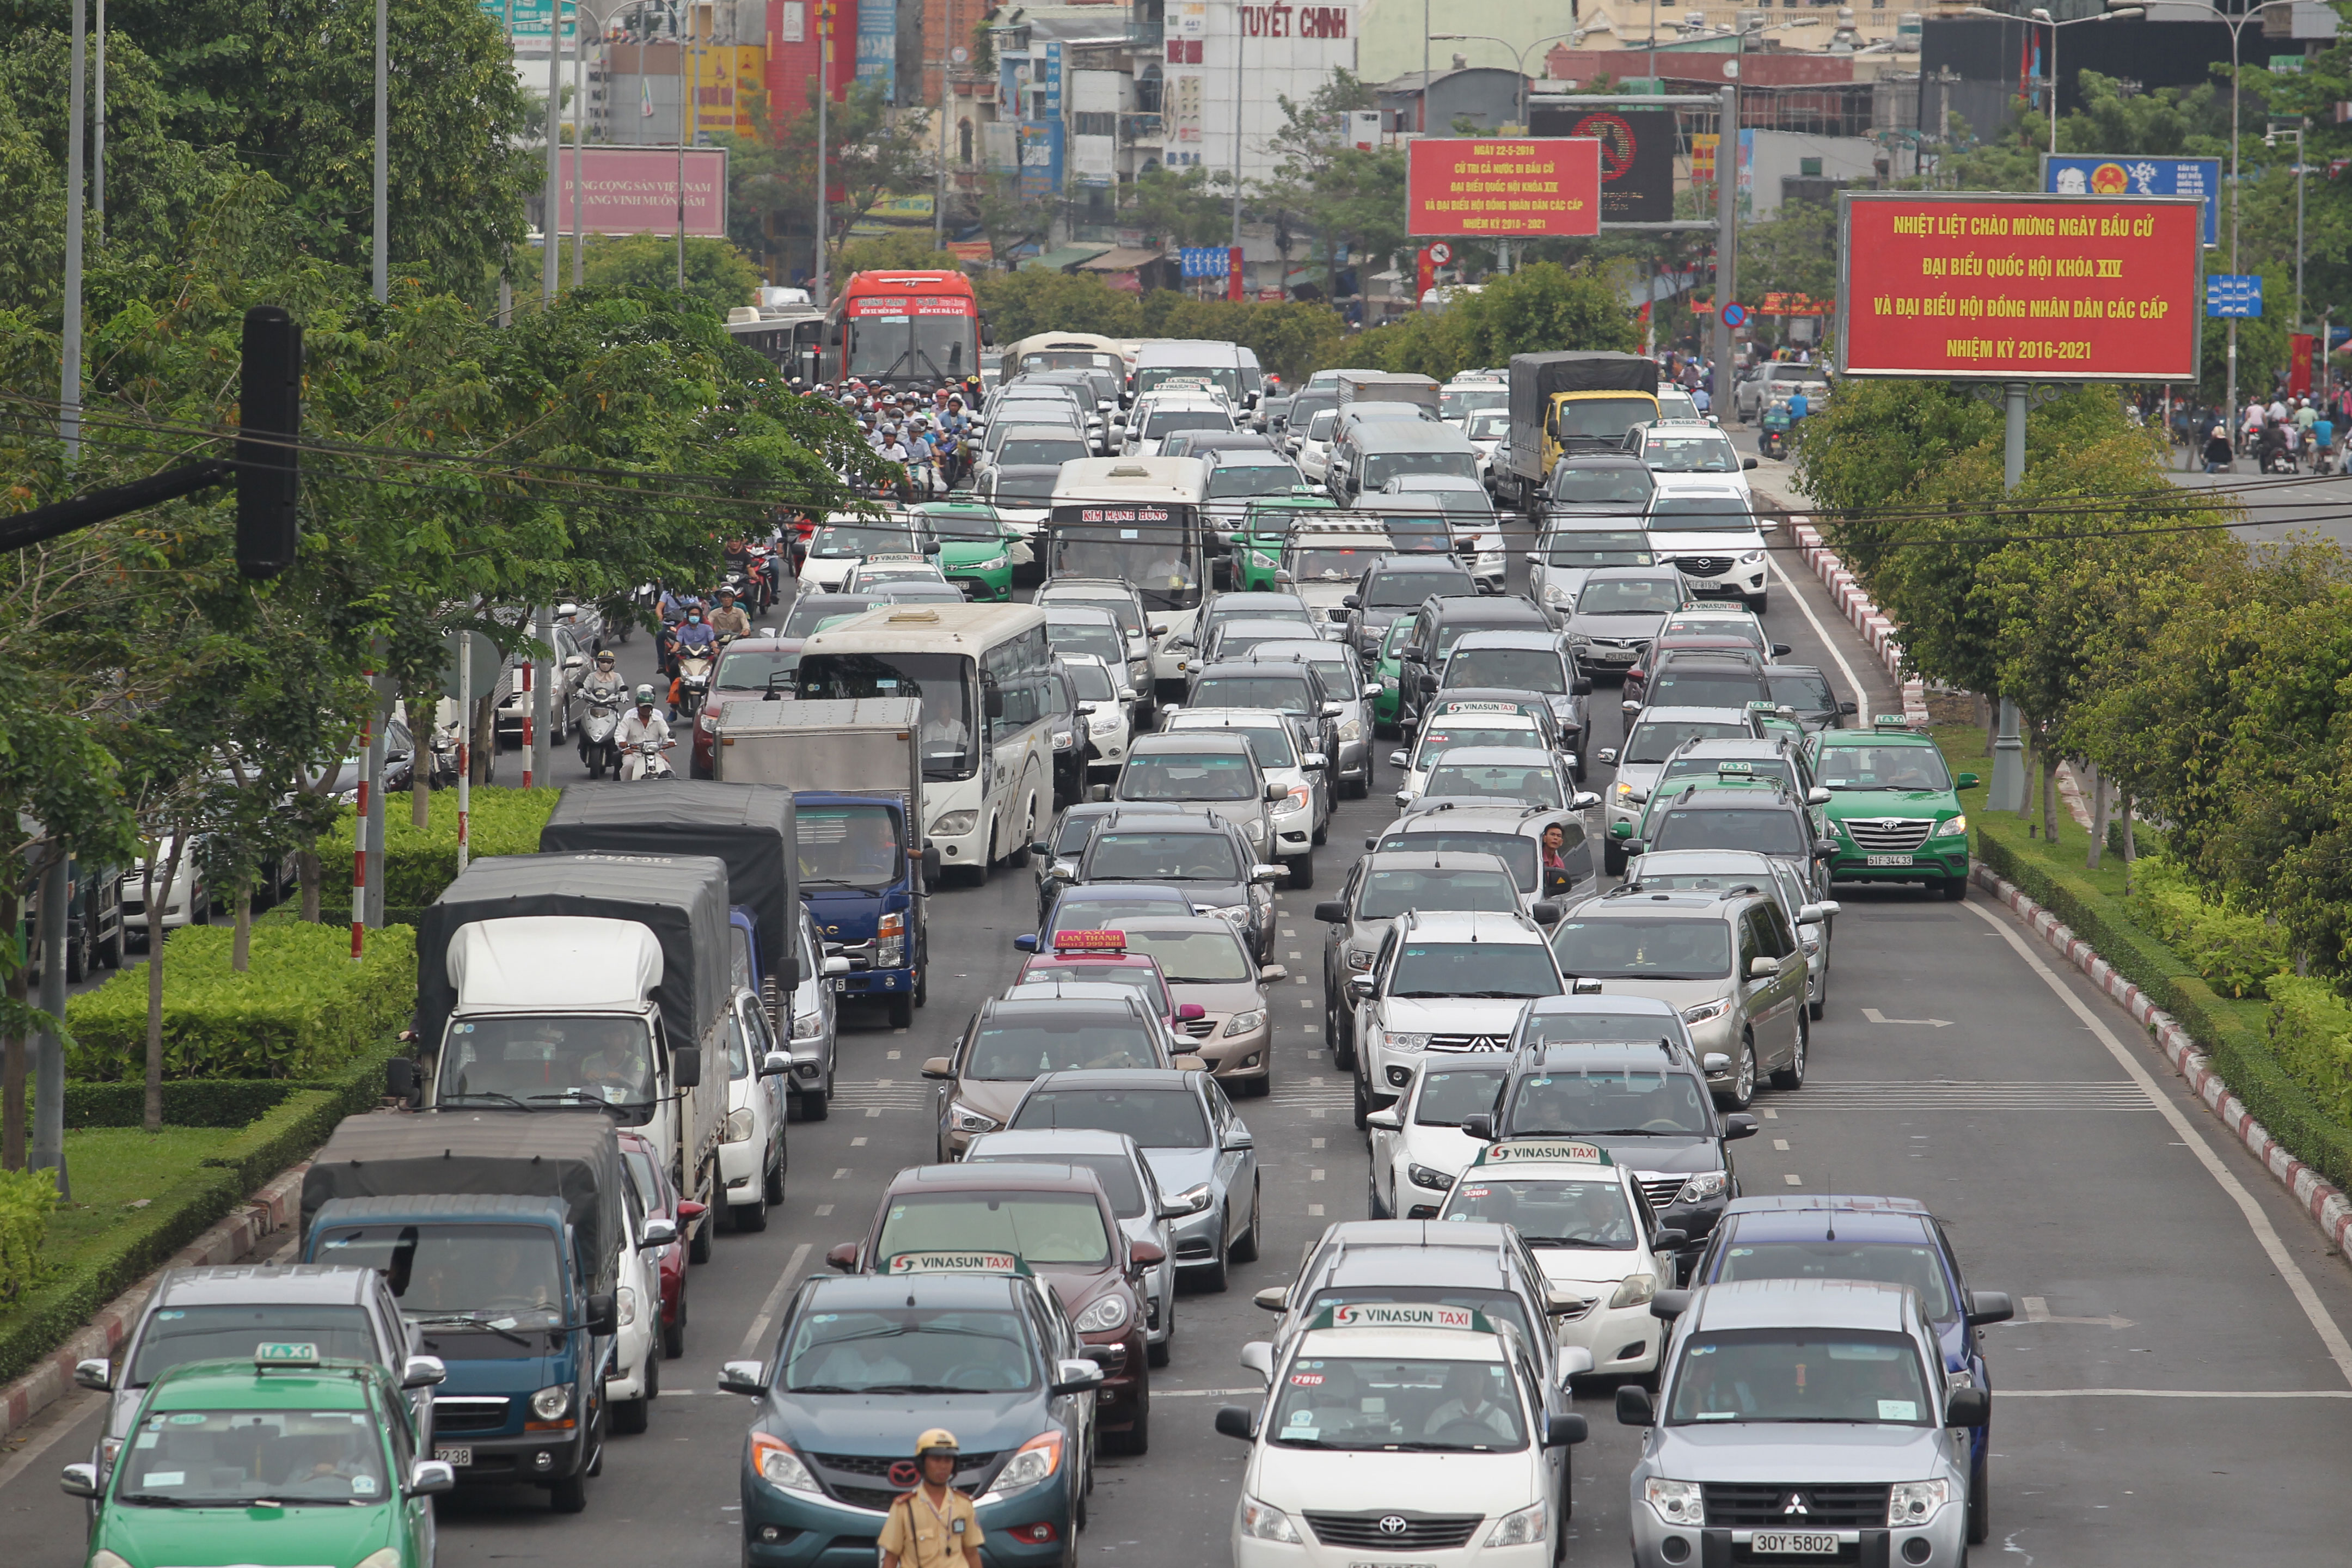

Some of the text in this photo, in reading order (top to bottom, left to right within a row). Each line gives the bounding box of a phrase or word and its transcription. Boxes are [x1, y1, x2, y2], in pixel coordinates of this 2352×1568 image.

[565, 180, 597, 190] ĐNG
[657, 182, 678, 193] VIỆ
[683, 182, 710, 192] NAM
[613, 195, 641, 205] VINH
[1894, 212, 2155, 239] NHIỆT LIỆT CHÀO MỪNG NGÀY BẦU CỬ
[1922, 251, 2123, 280] ĐẠI BIỂU QUỐC HỘI KHÓA XIV
[1873, 291, 2169, 320] VÀ ĐẠI BIỂU HỘI ĐỒNG NHÂN DÂN CÁC CẤP
[1946, 336, 2091, 362] NHIỆM KỲ 2016-2021
[1082, 510, 1102, 522] KIM
[1105, 509, 1135, 524] MẠNH
[1869, 856, 1912, 865] 51F-344.33
[1366, 1309, 1469, 1325] VINASUN TAXI
